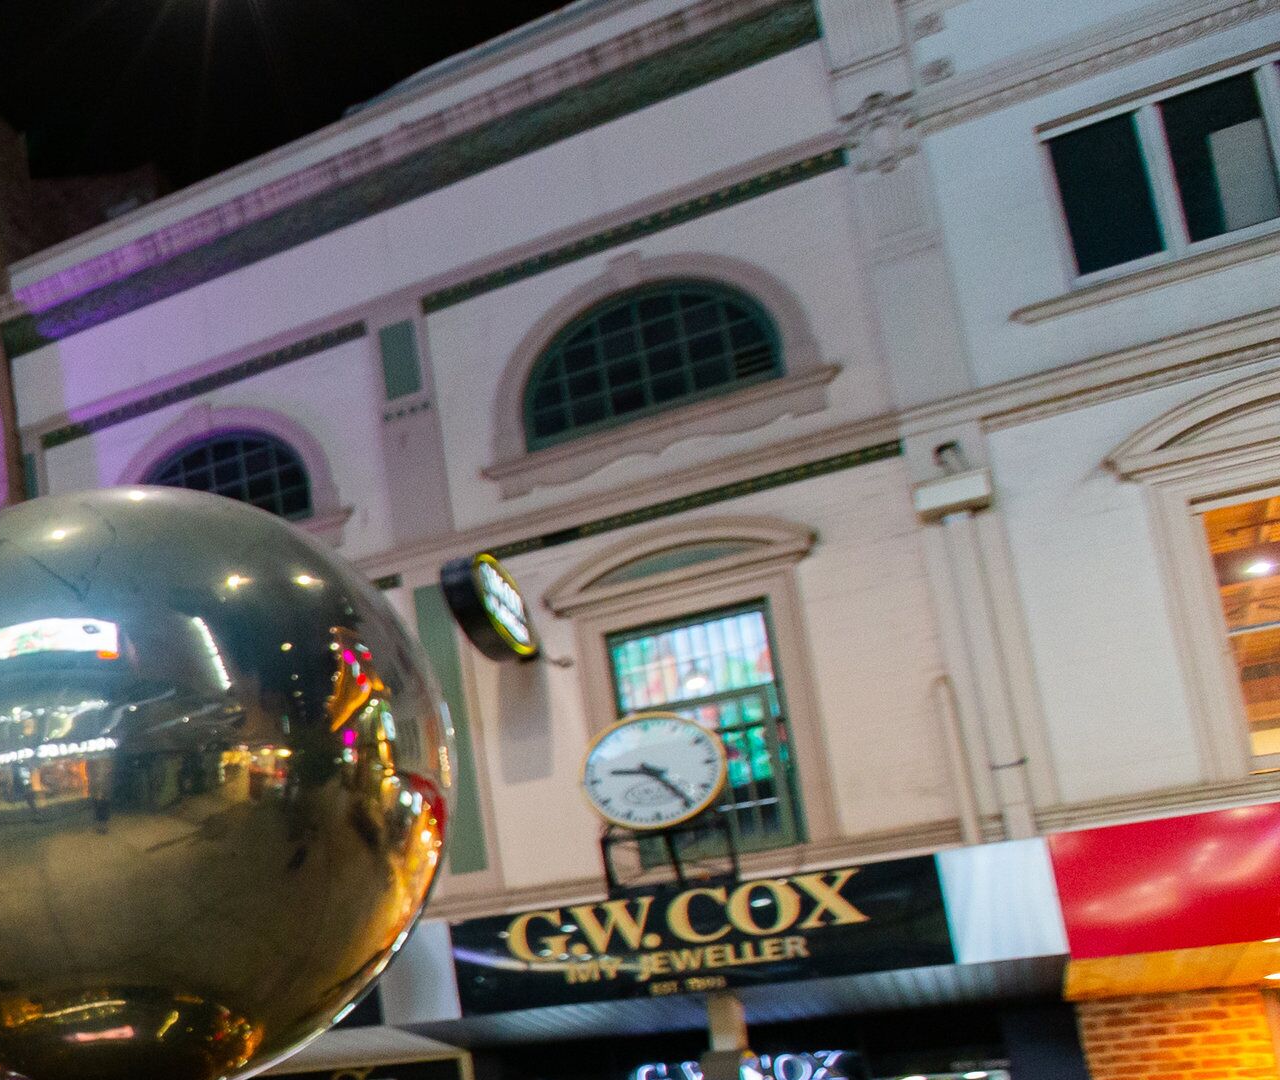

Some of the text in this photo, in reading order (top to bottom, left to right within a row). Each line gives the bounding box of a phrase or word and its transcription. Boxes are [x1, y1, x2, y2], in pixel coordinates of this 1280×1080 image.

[666, 868, 870, 943] COX
[564, 935, 811, 985] MY JEWELLER
